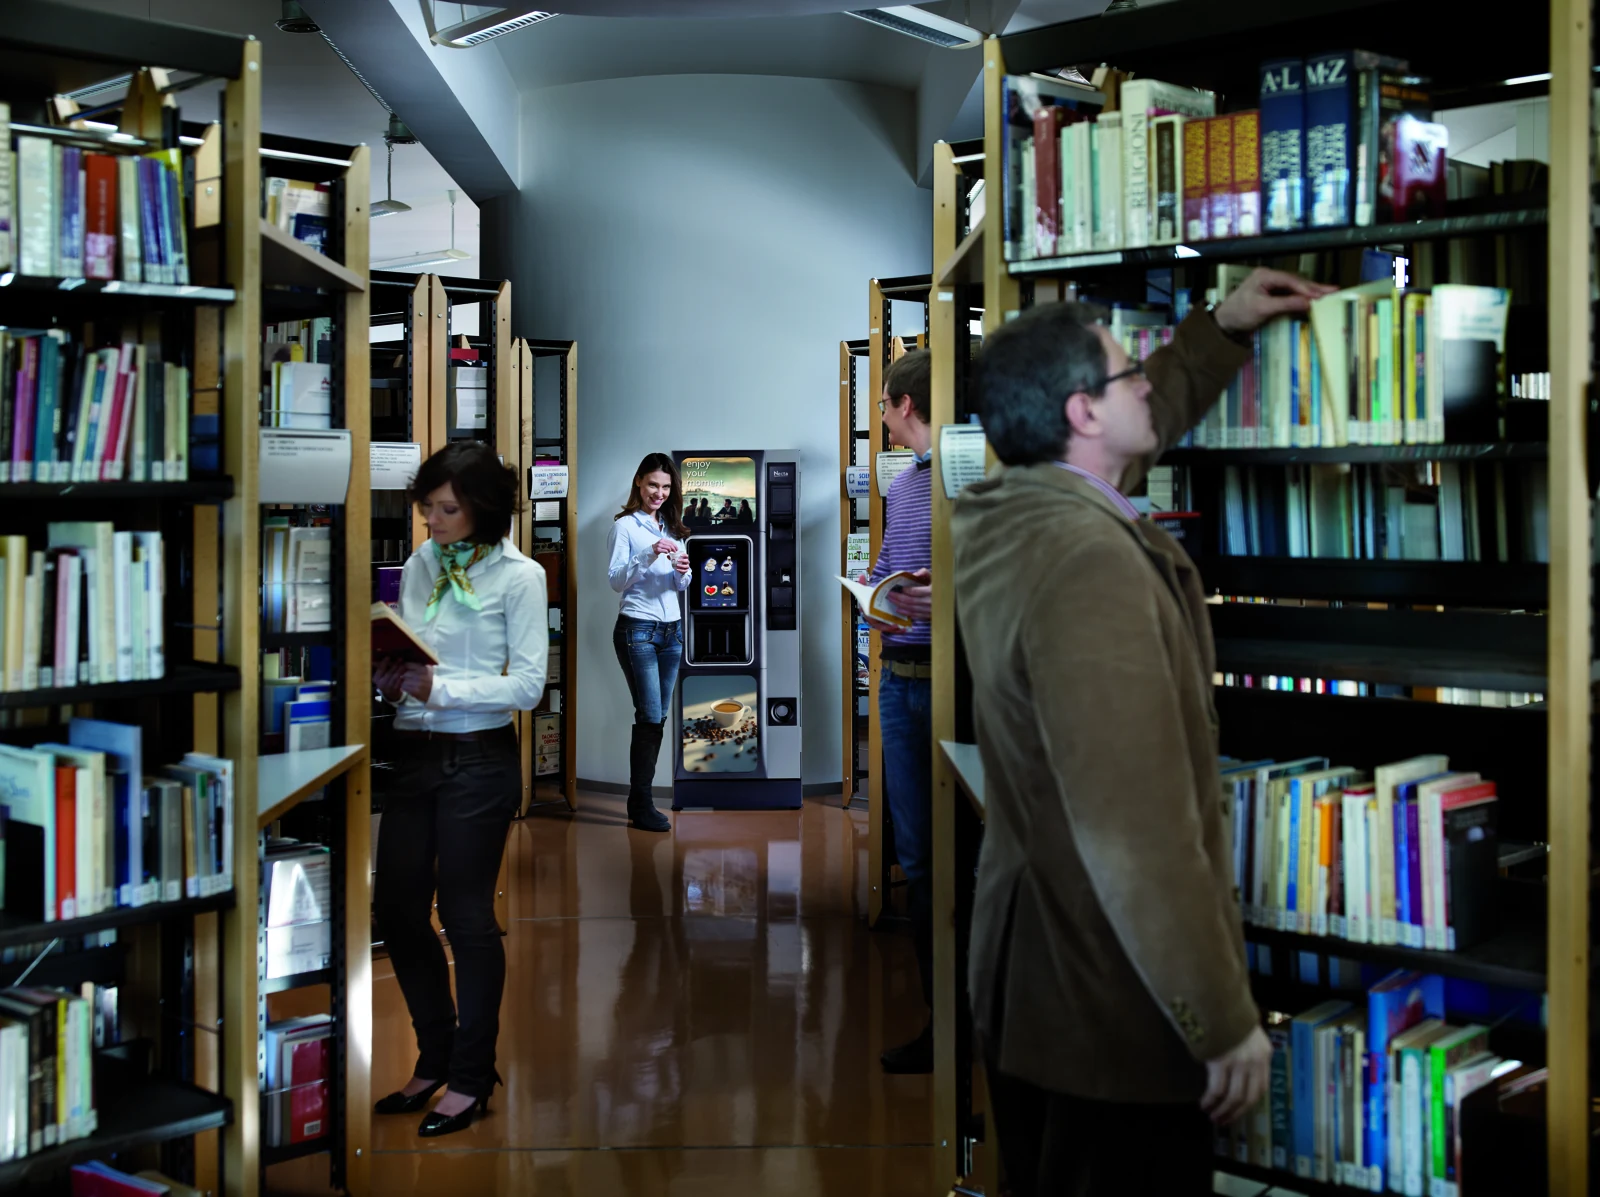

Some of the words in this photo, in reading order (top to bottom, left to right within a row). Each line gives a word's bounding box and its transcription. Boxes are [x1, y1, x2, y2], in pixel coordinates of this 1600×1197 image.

[1131, 113, 1146, 209] RELIGIONI
[686, 460, 711, 469] enjoy
[686, 470, 707, 478] your
[773, 470, 789, 478] Necta
[686, 479, 724, 487] moment
